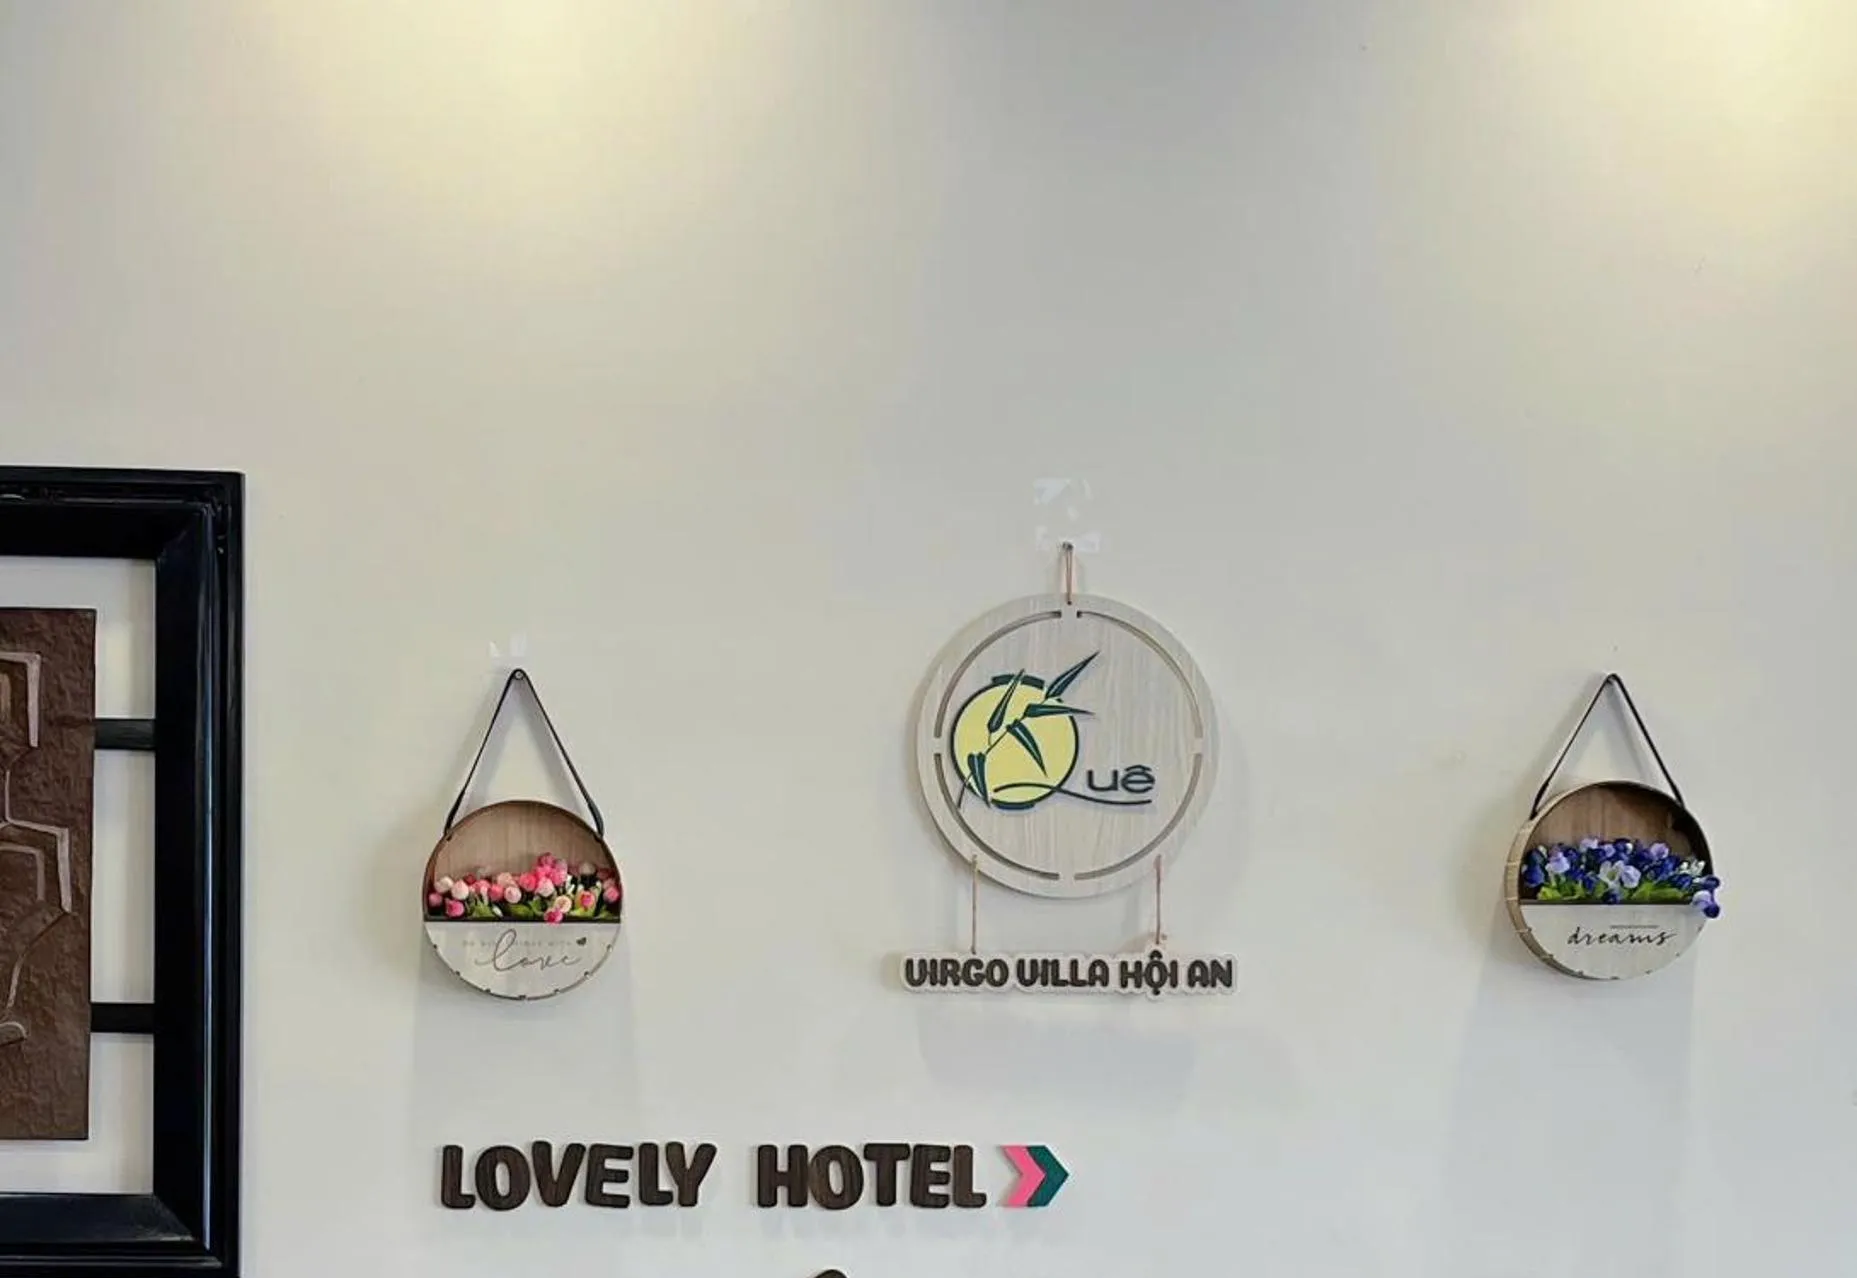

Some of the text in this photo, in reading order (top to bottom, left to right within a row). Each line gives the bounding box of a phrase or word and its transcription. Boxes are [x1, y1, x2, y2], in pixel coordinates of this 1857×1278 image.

[474, 928, 581, 972] love
[1567, 926, 1678, 946] dreams
[1120, 950, 1179, 996] HỘI
[1187, 958, 1234, 989] AN
[441, 1141, 988, 1211] LOVELY HOTEL
